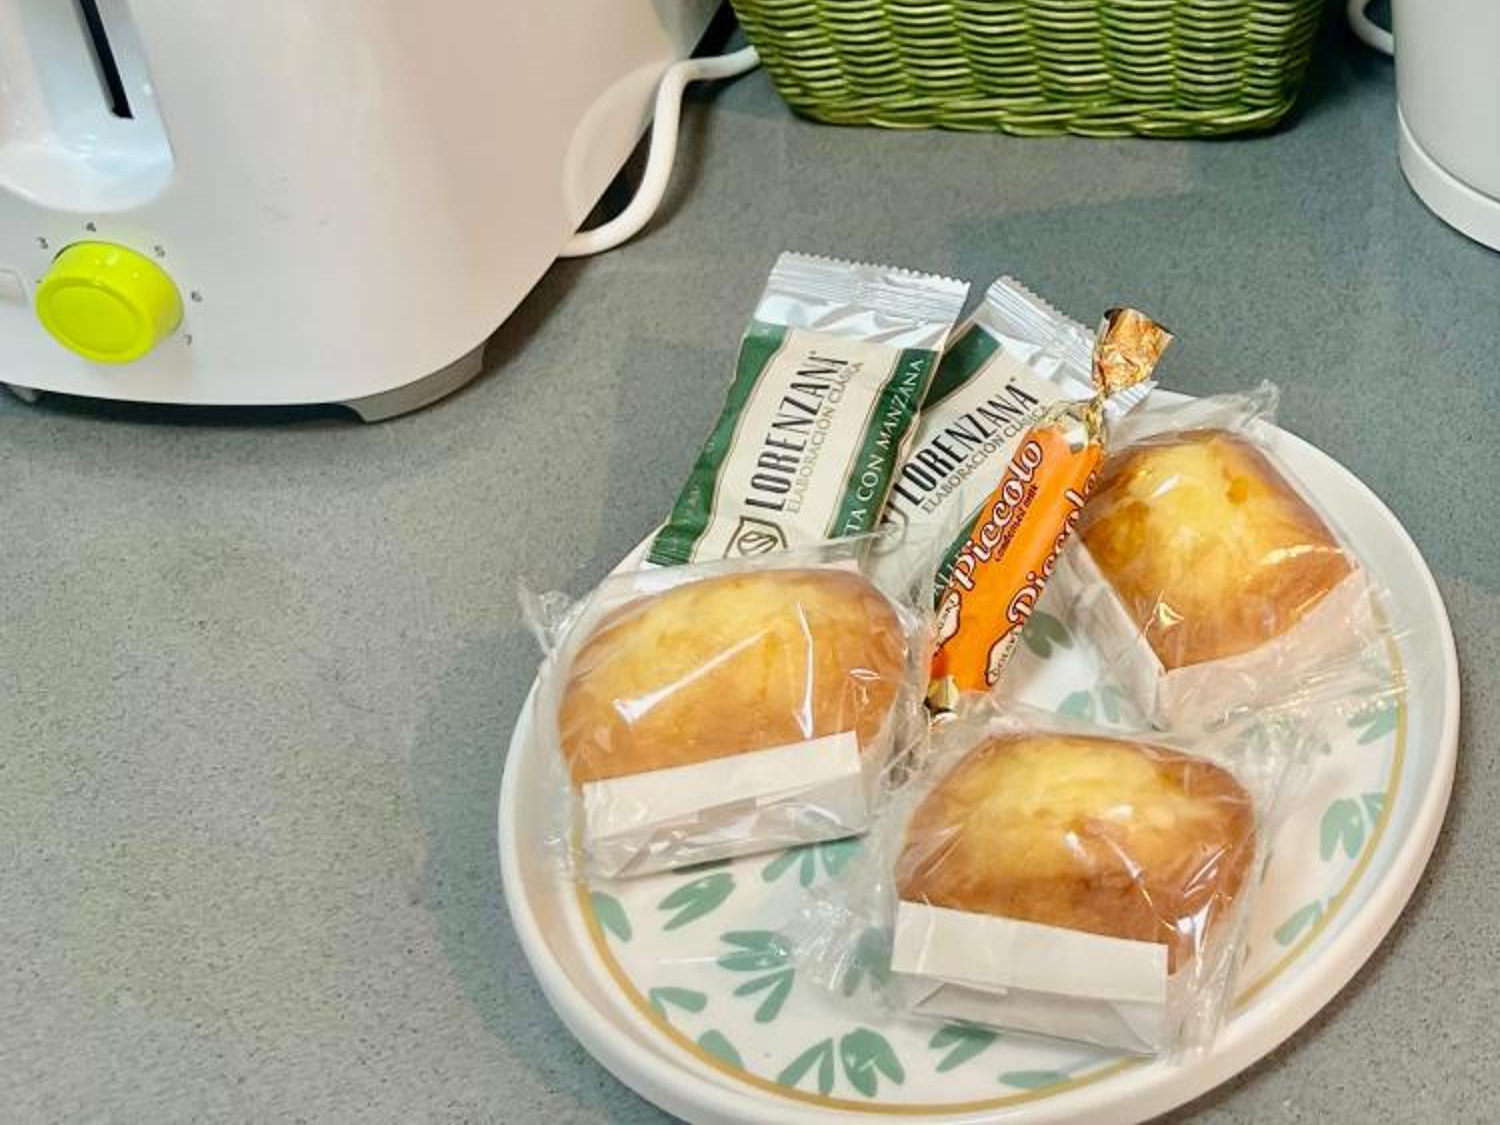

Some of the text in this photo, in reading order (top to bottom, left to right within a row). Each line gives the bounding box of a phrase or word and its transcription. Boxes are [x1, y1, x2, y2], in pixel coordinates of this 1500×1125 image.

[855, 453, 885, 502] CON
[875, 358, 925, 451] MANZANA
[893, 383, 1040, 508] LORENZANA
[952, 438, 1044, 592] Piccolo
